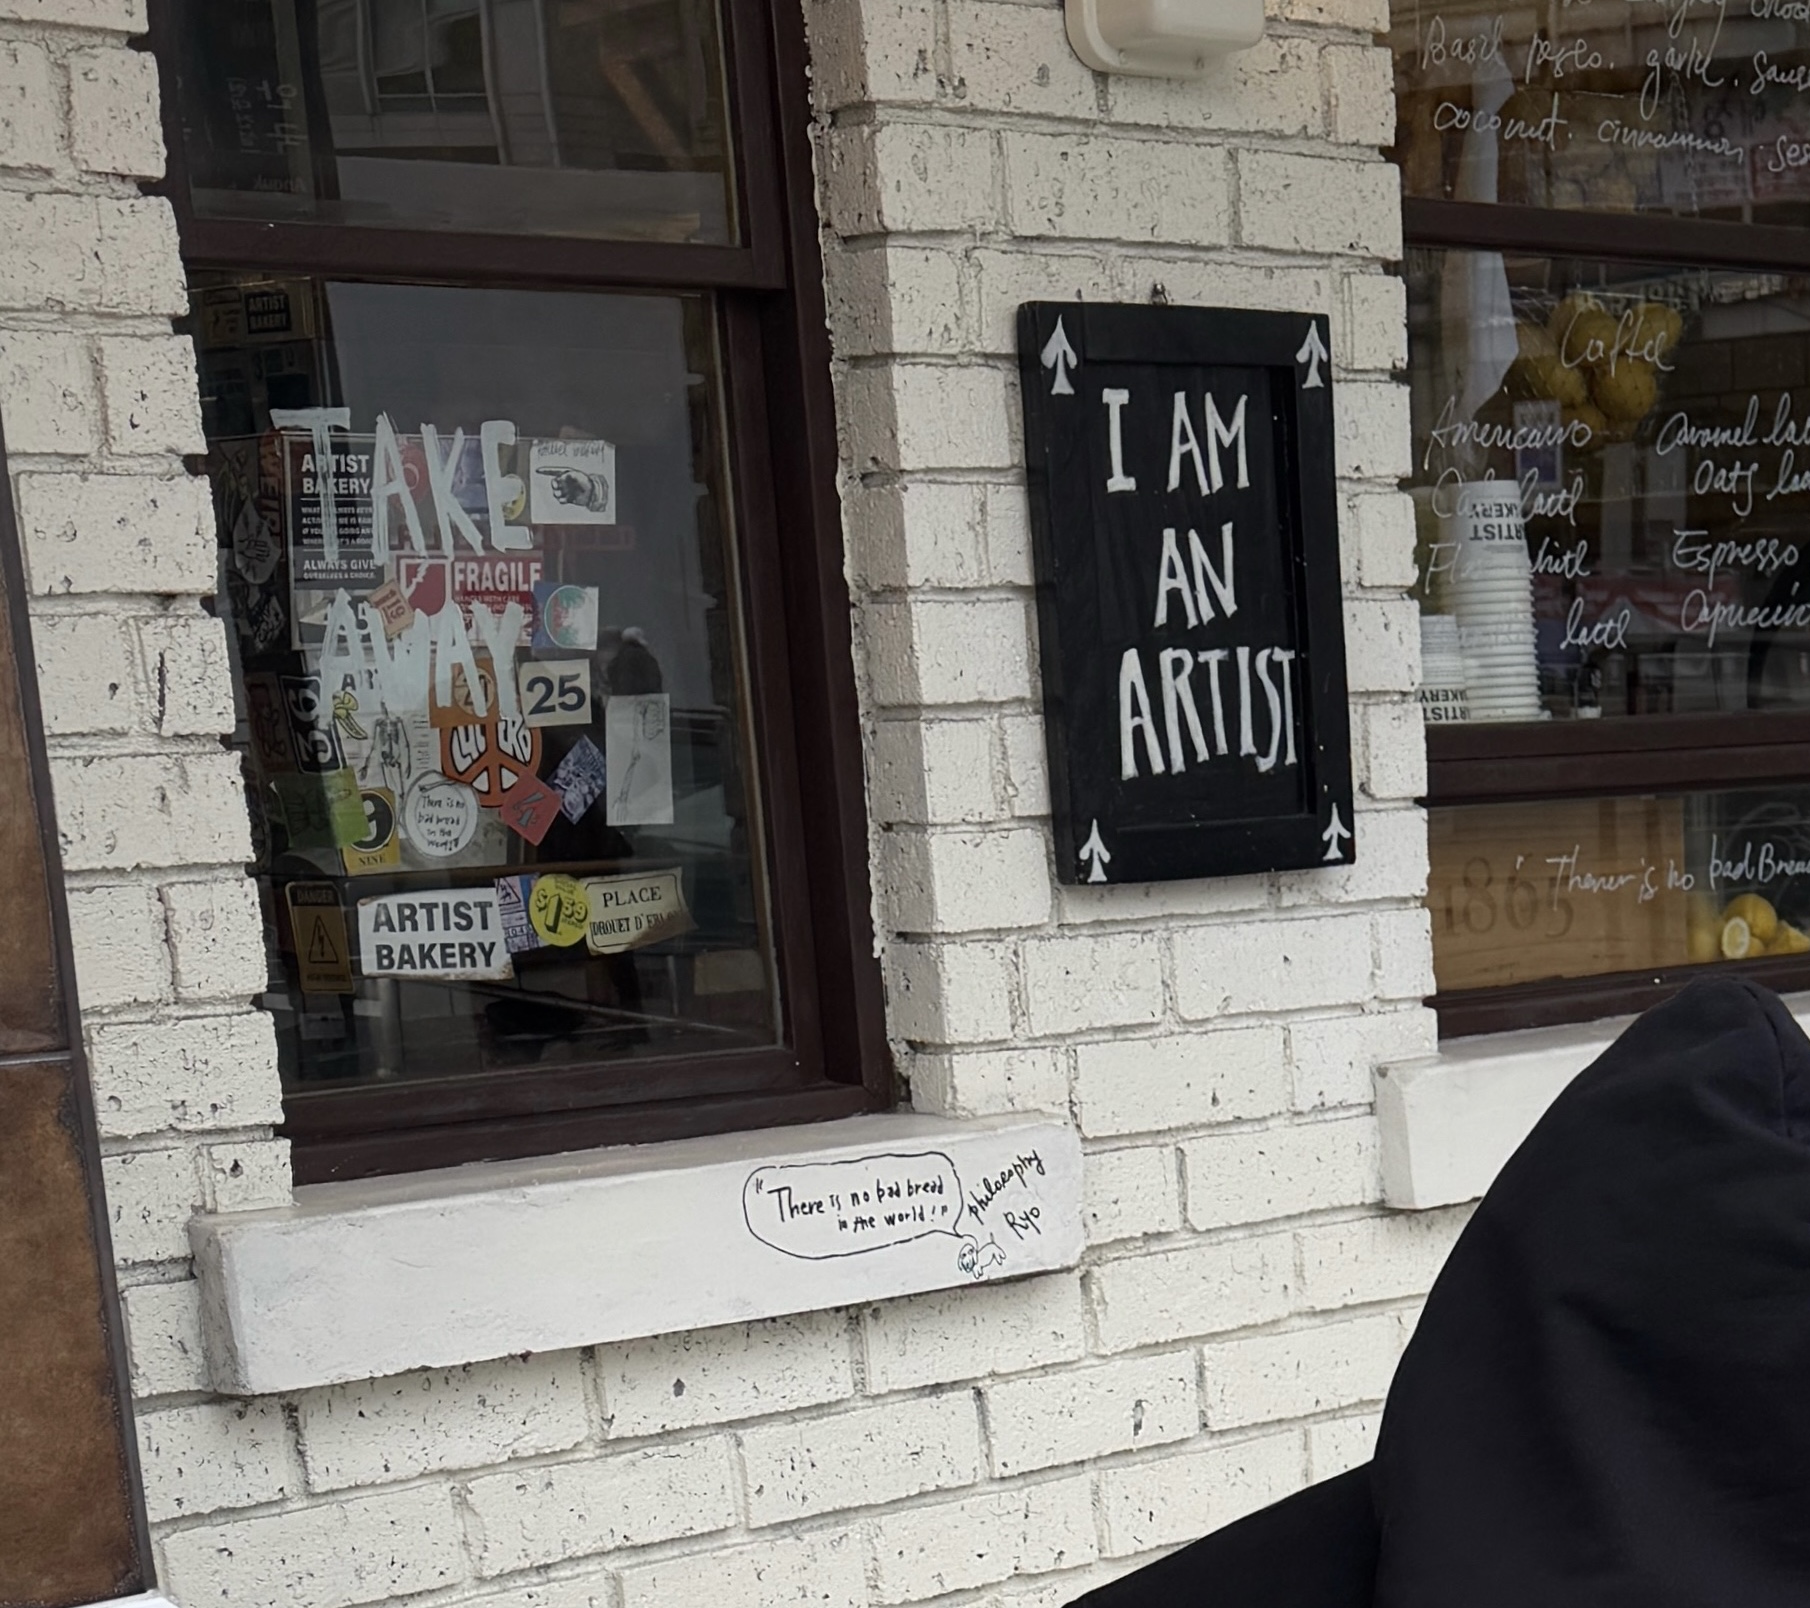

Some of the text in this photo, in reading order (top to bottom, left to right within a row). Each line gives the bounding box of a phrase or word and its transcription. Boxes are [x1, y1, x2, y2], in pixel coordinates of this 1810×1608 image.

[1422, 15, 1504, 70] Basil
[1102, 388, 1250, 497] I AM
[270, 406, 533, 565] TAKE
[1154, 522, 1238, 630] AN
[1672, 528, 1800, 592] Espresso
[319, 587, 525, 717] AWAY
[524, 672, 587, 716] 25
[1119, 646, 1298, 781] ARTIST
[372, 899, 495, 935] ARTIST
[602, 886, 663, 909] PLACE
[374, 940, 498, 972] BAKERY
[829, 1193, 842, 1212] is
[850, 1189, 871, 1208] no
[875, 1177, 901, 1201] bad
[905, 1174, 945, 1199] bread
[836, 1212, 849, 1232] in
[852, 1211, 877, 1234] the
[1002, 1205, 1043, 1242] Ryo
